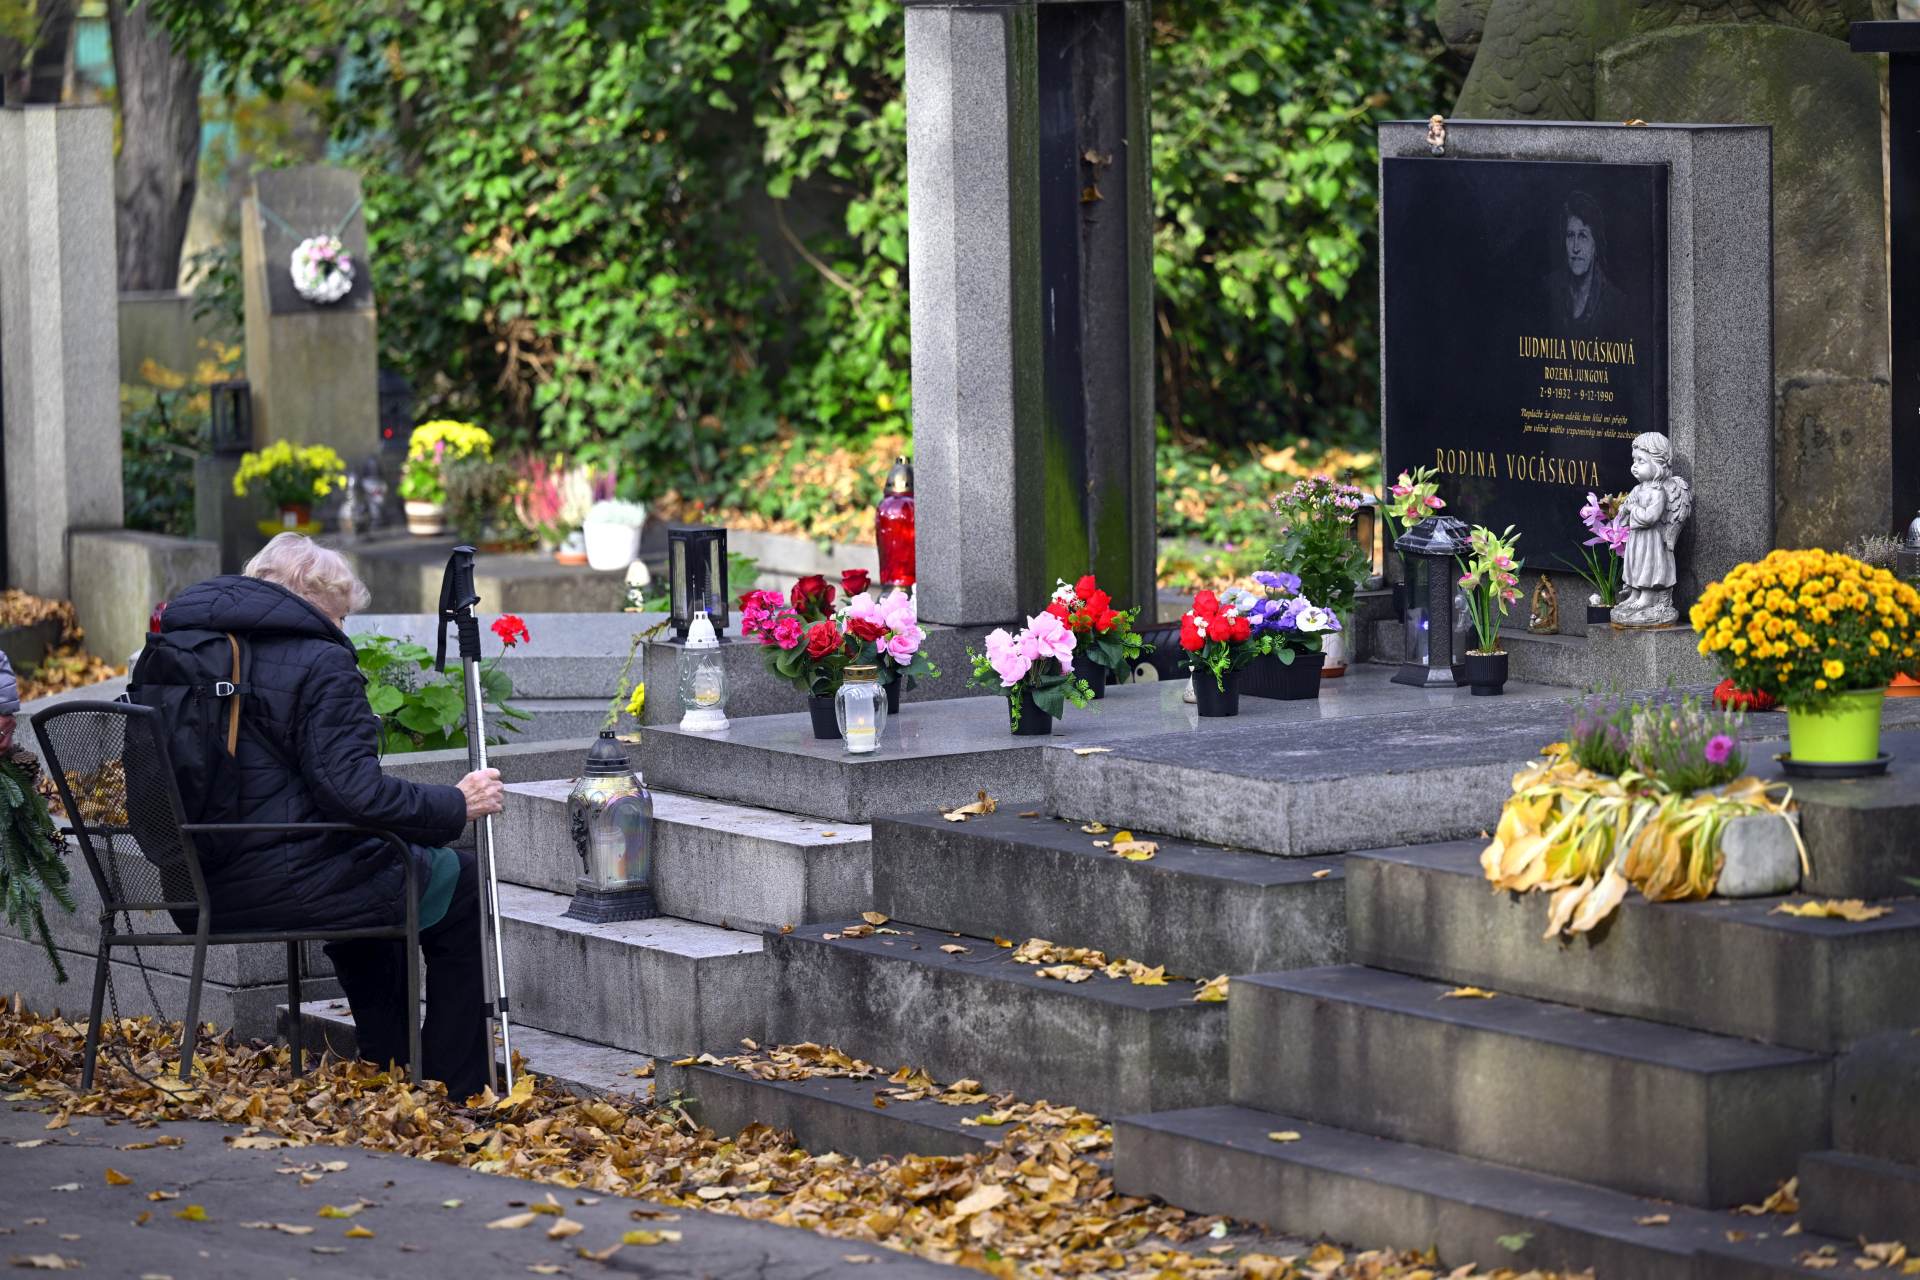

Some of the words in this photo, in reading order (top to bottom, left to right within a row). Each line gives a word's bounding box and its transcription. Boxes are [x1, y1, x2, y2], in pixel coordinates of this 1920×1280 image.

[1519, 336, 1567, 360] LUDMILA
[1570, 336, 1635, 364] VOCÁSKOVÁ
[1544, 364, 1573, 381] ROZENÁ
[1574, 367, 1609, 383] JUNGOVÁ
[1436, 448, 1497, 478] RODINA
[1506, 450, 1599, 487] VOCÁSKOVA
